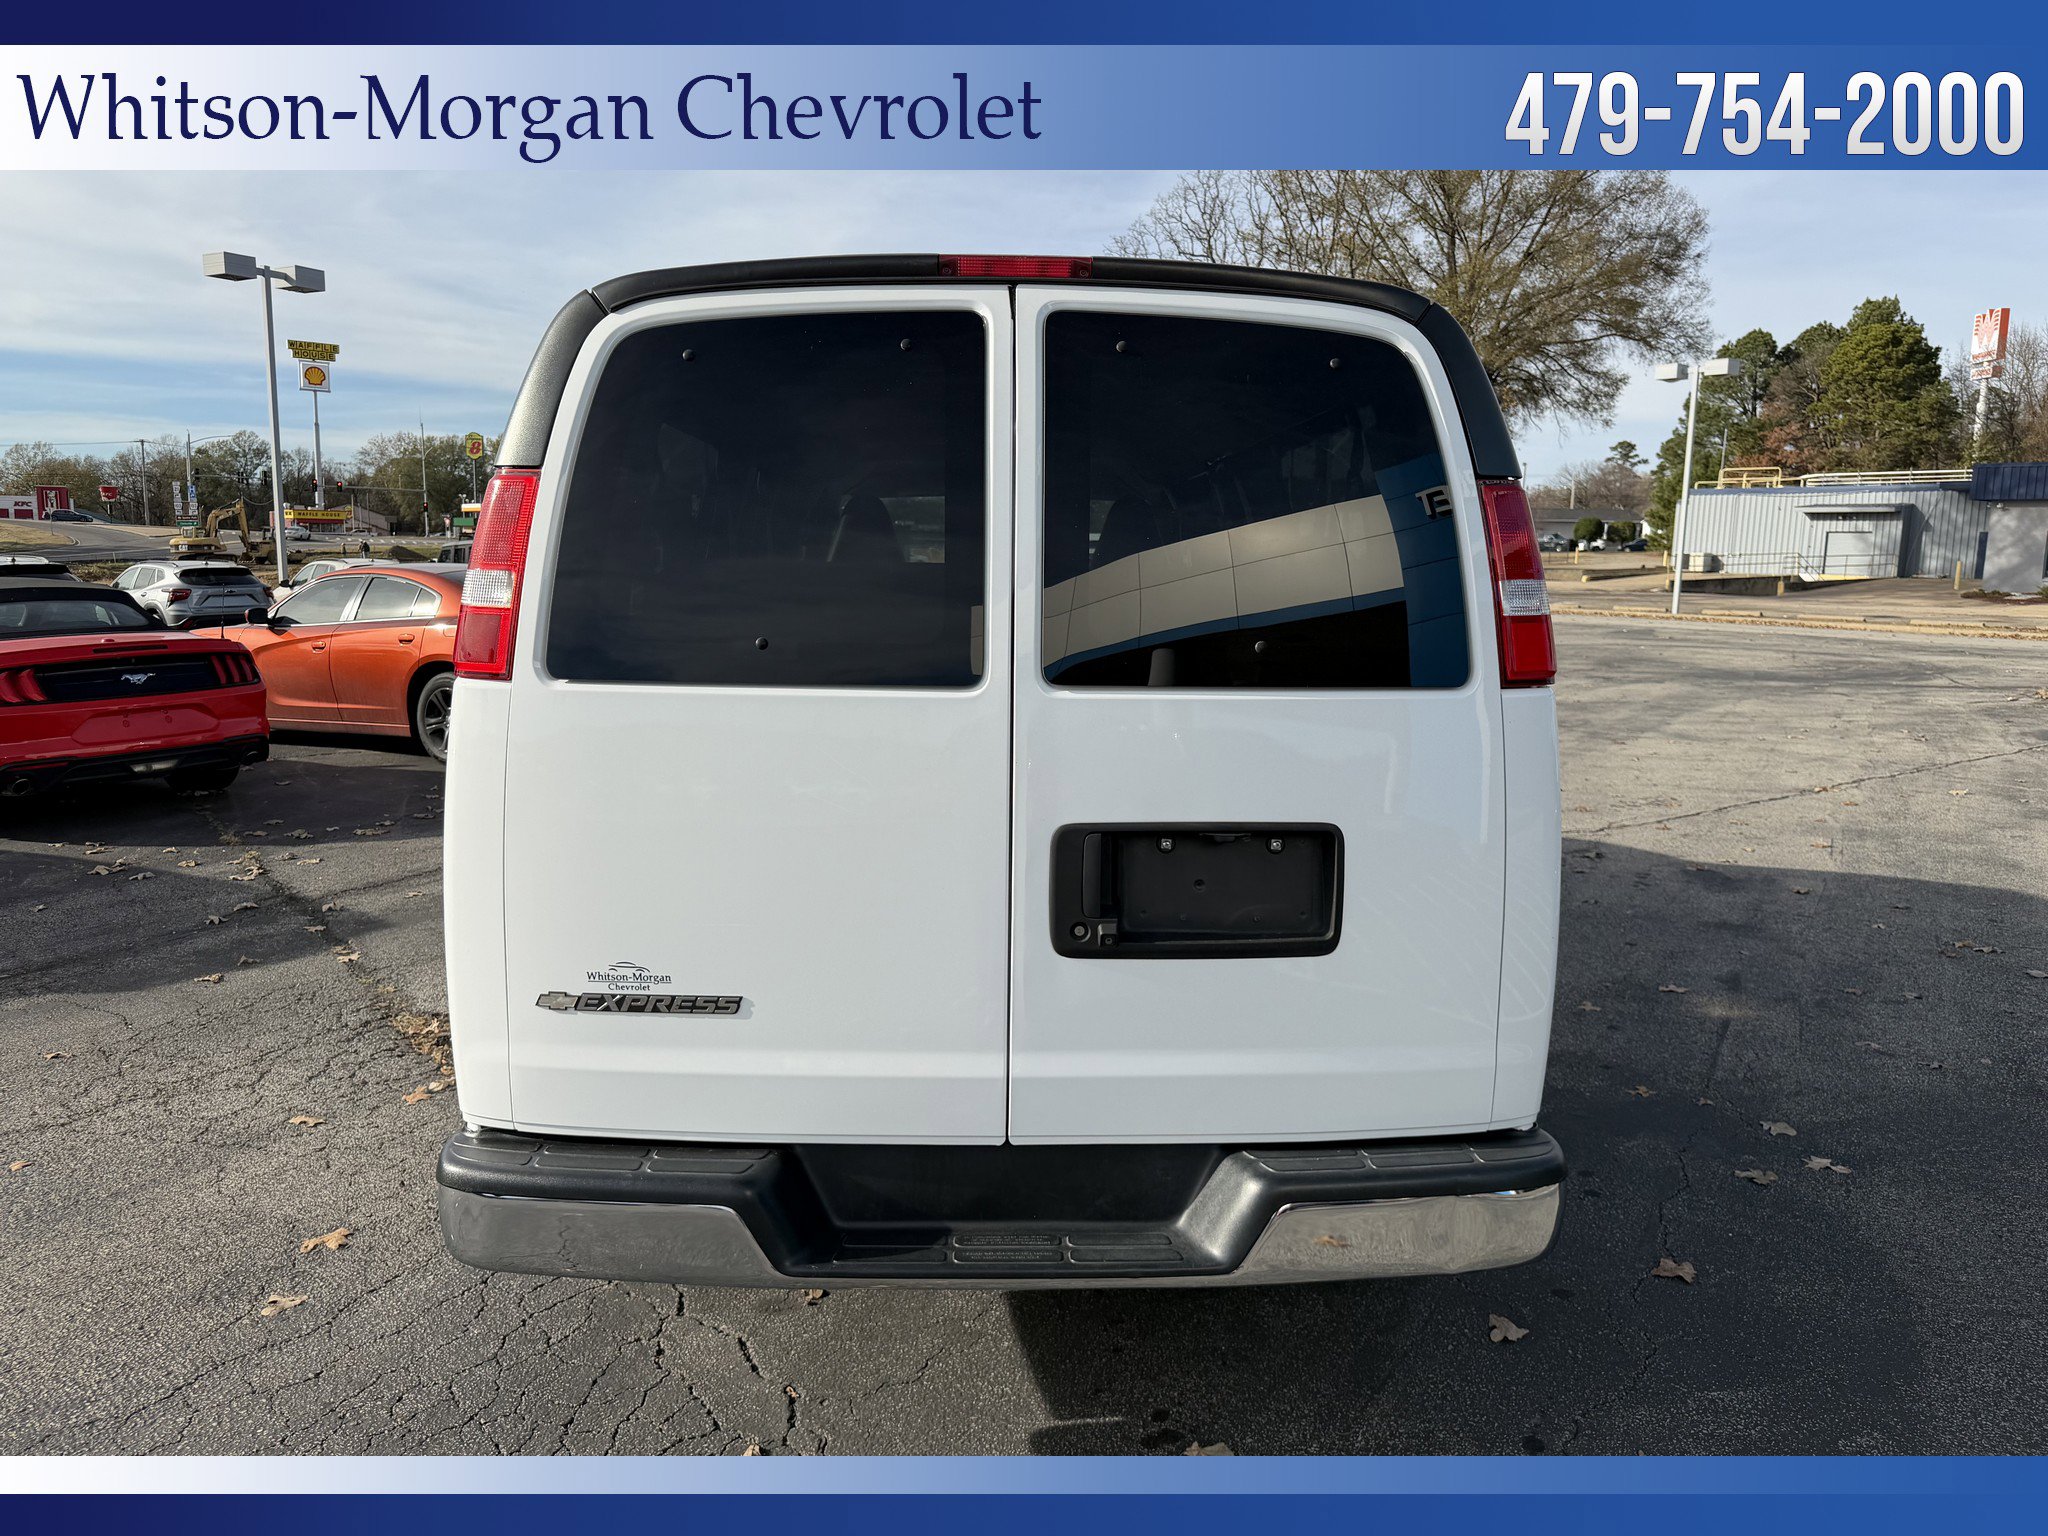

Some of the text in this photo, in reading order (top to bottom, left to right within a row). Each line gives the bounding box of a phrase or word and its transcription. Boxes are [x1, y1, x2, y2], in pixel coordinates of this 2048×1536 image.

[289, 341, 338, 352] WAFFLE
[294, 350, 334, 360] HOUSE
[586, 971, 672, 985] Whitson-Morgan
[607, 983, 651, 991] Chevrolet
[576, 993, 742, 1014] EXPRESS
